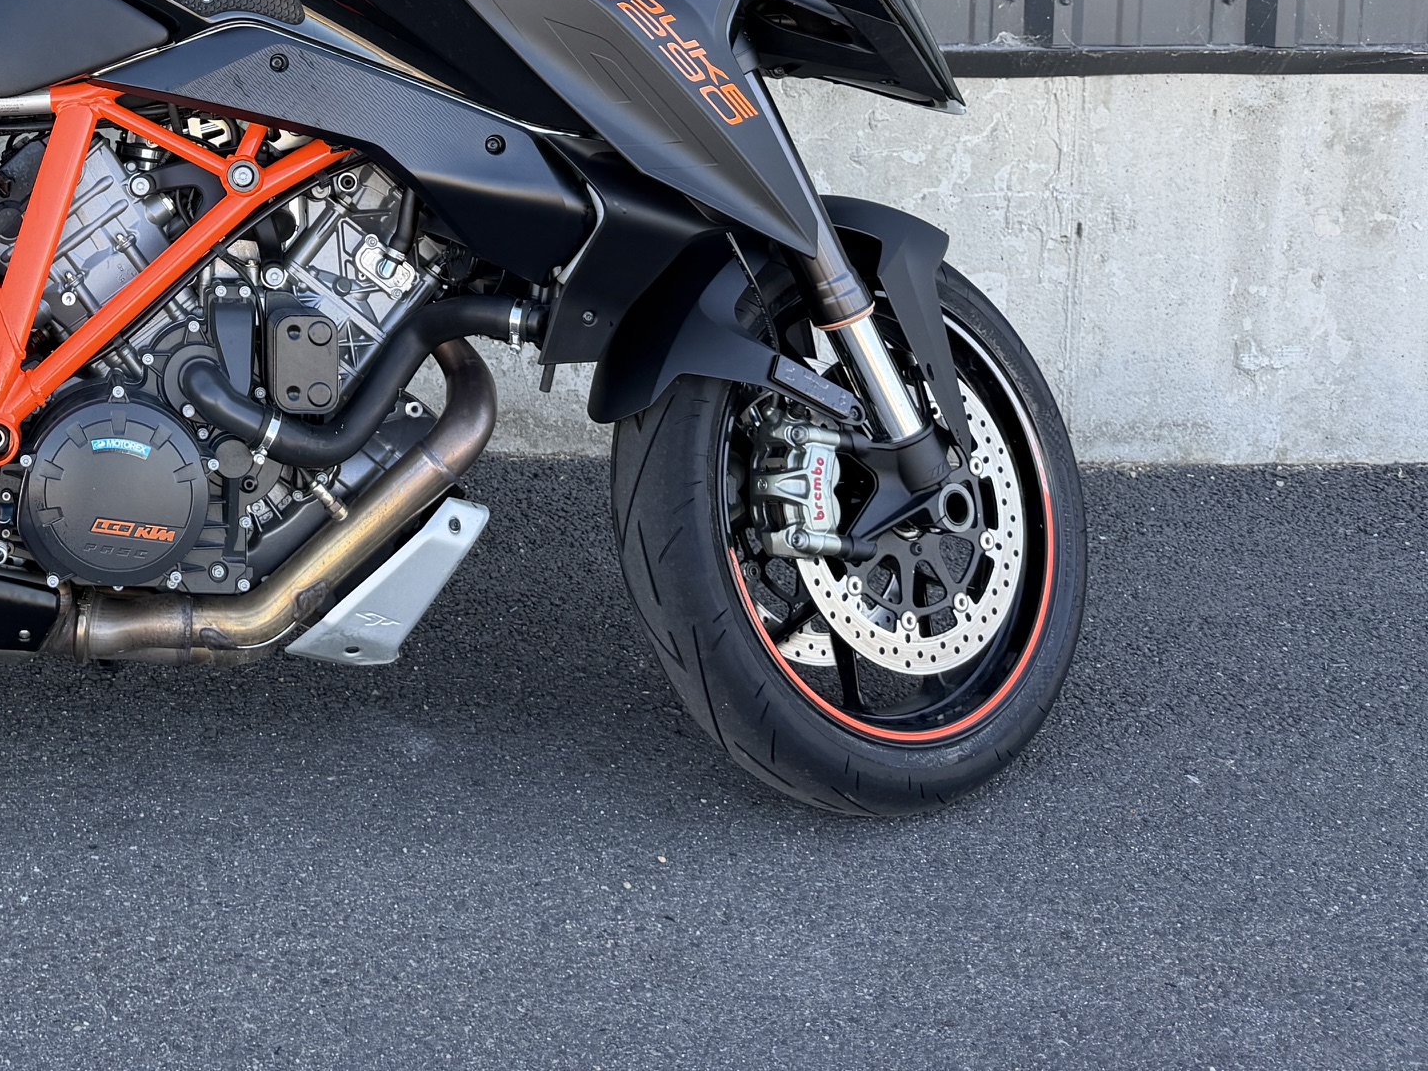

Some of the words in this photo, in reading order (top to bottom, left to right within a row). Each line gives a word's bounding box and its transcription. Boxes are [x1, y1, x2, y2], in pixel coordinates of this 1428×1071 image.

[106, 438, 147, 454] MOTOREX
[811, 456, 825, 521] brembo
[134, 524, 176, 542] KTM
